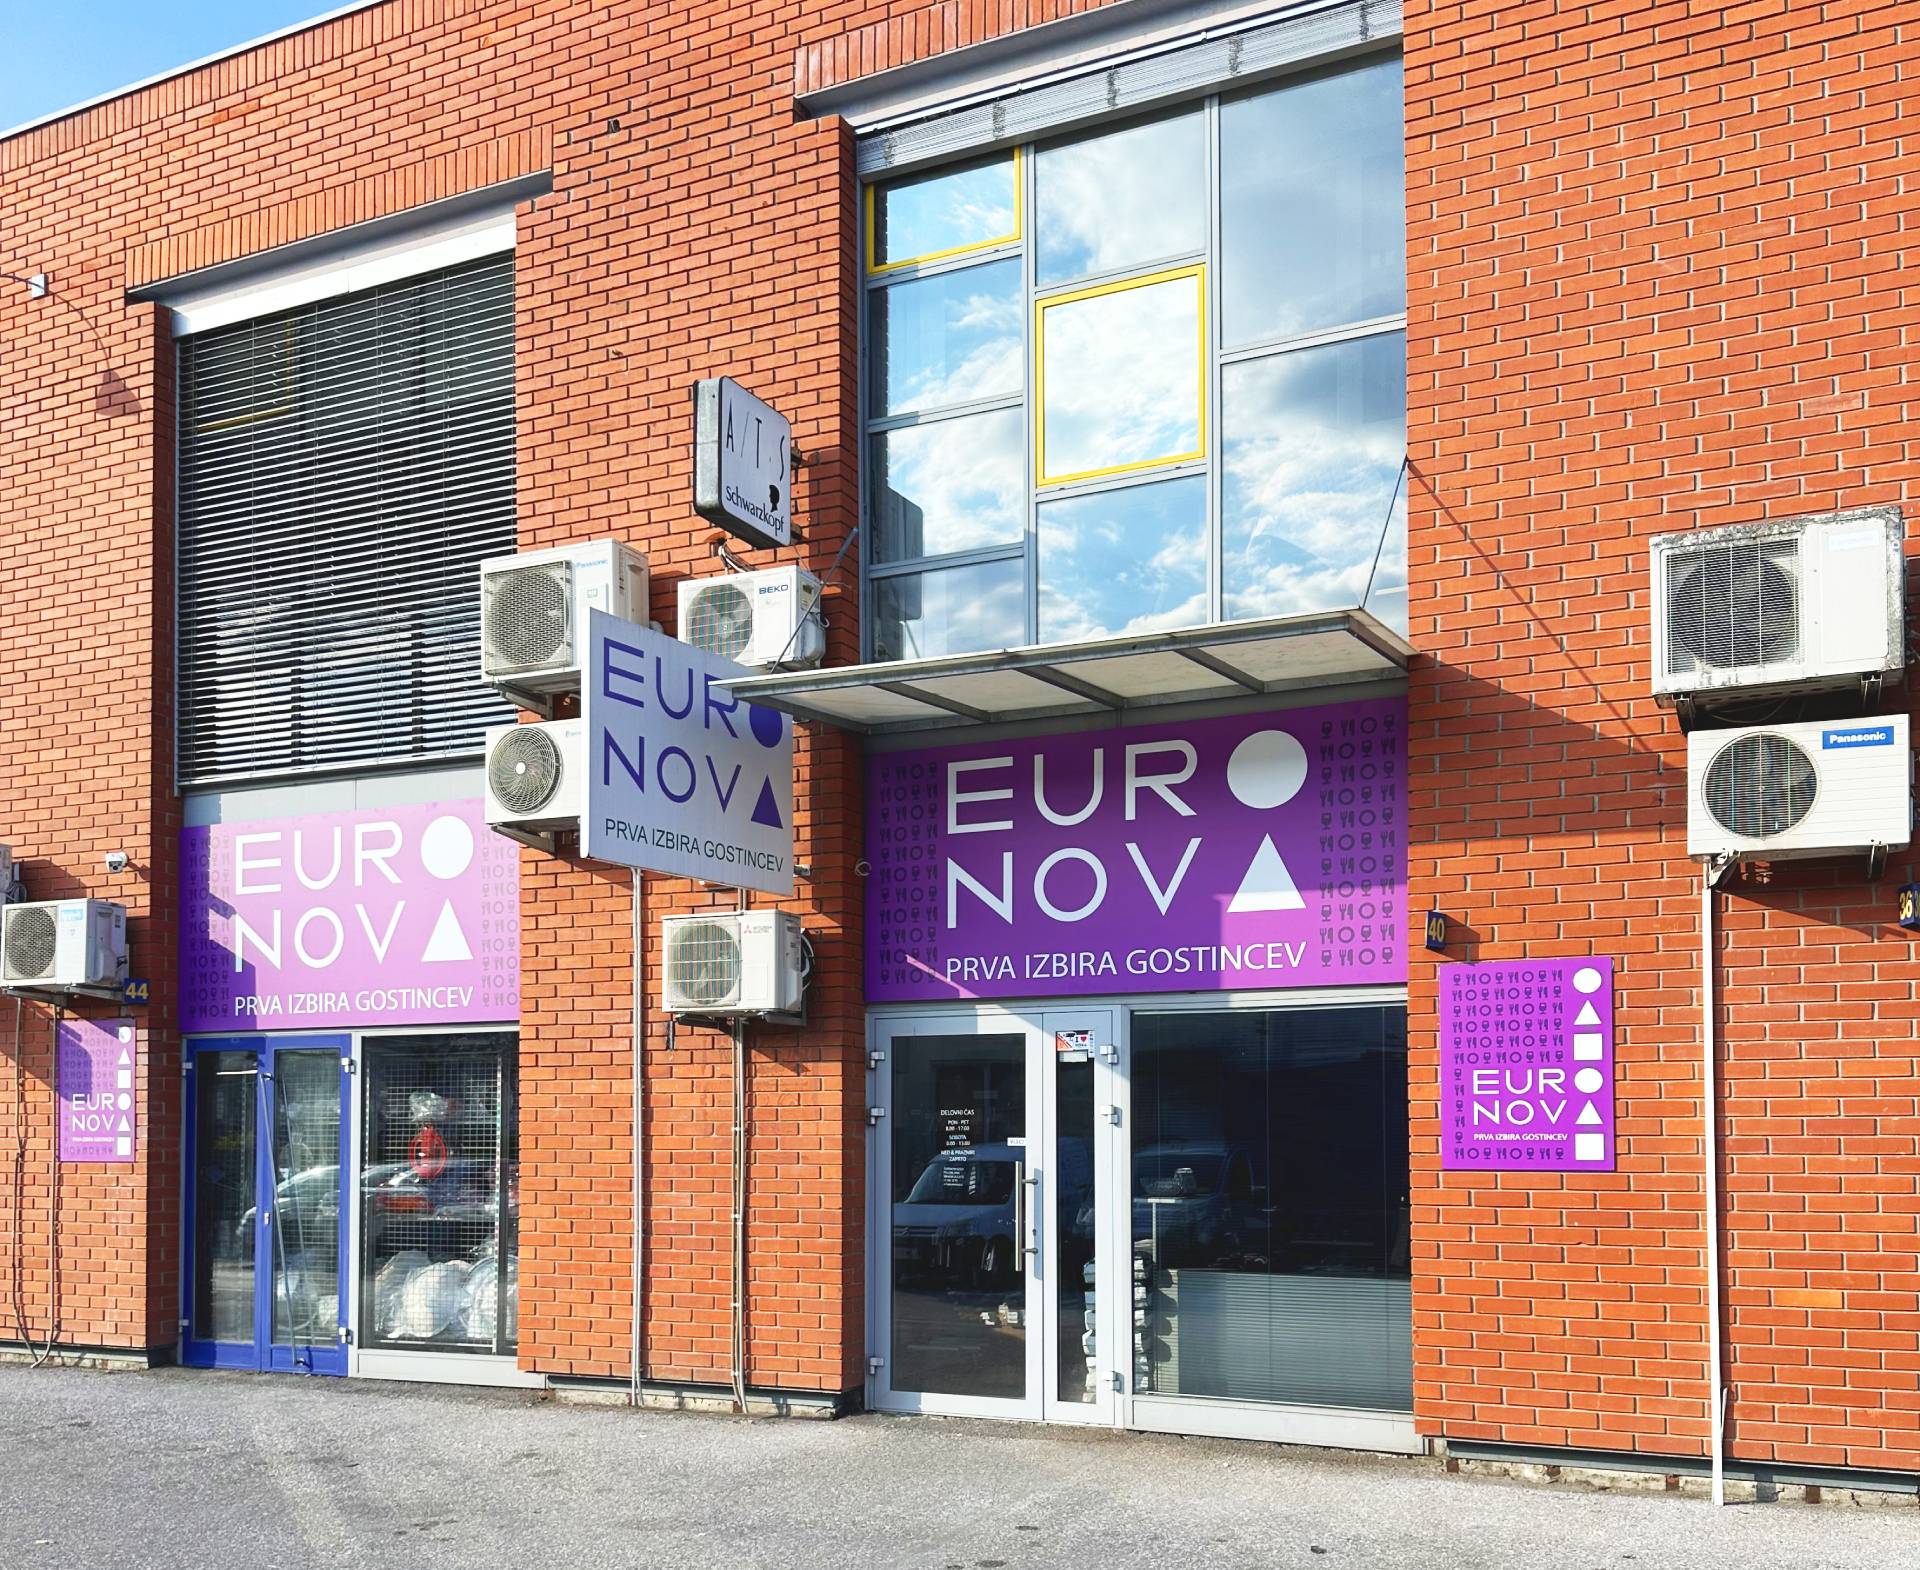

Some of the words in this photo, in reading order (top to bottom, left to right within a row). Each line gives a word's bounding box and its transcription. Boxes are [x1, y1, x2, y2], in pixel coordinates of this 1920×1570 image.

[726, 485, 785, 536] Schwarzkopf
[759, 584, 789, 594] BEKO
[1830, 731, 1887, 744] Panasonic
[605, 818, 648, 844] PRVA
[652, 829, 700, 855] IZBIRA
[704, 840, 784, 873] GOSTINCEV
[1899, 890, 1913, 920] 36
[1429, 918, 1445, 942] 40
[946, 956, 1016, 982] PRVA
[1024, 951, 1117, 979] IZBIRA
[1126, 941, 1307, 974] GOSTINCEV
[126, 982, 149, 999] 44
[235, 996, 283, 1016] PRVA
[288, 991, 350, 1014] IZBIRA
[356, 986, 474, 1011] GOSTINCEV
[1473, 1133, 1494, 1141] PRVA
[1495, 1133, 1521, 1141] IZBIRA
[1521, 1133, 1568, 1141] GOSTINCEV
